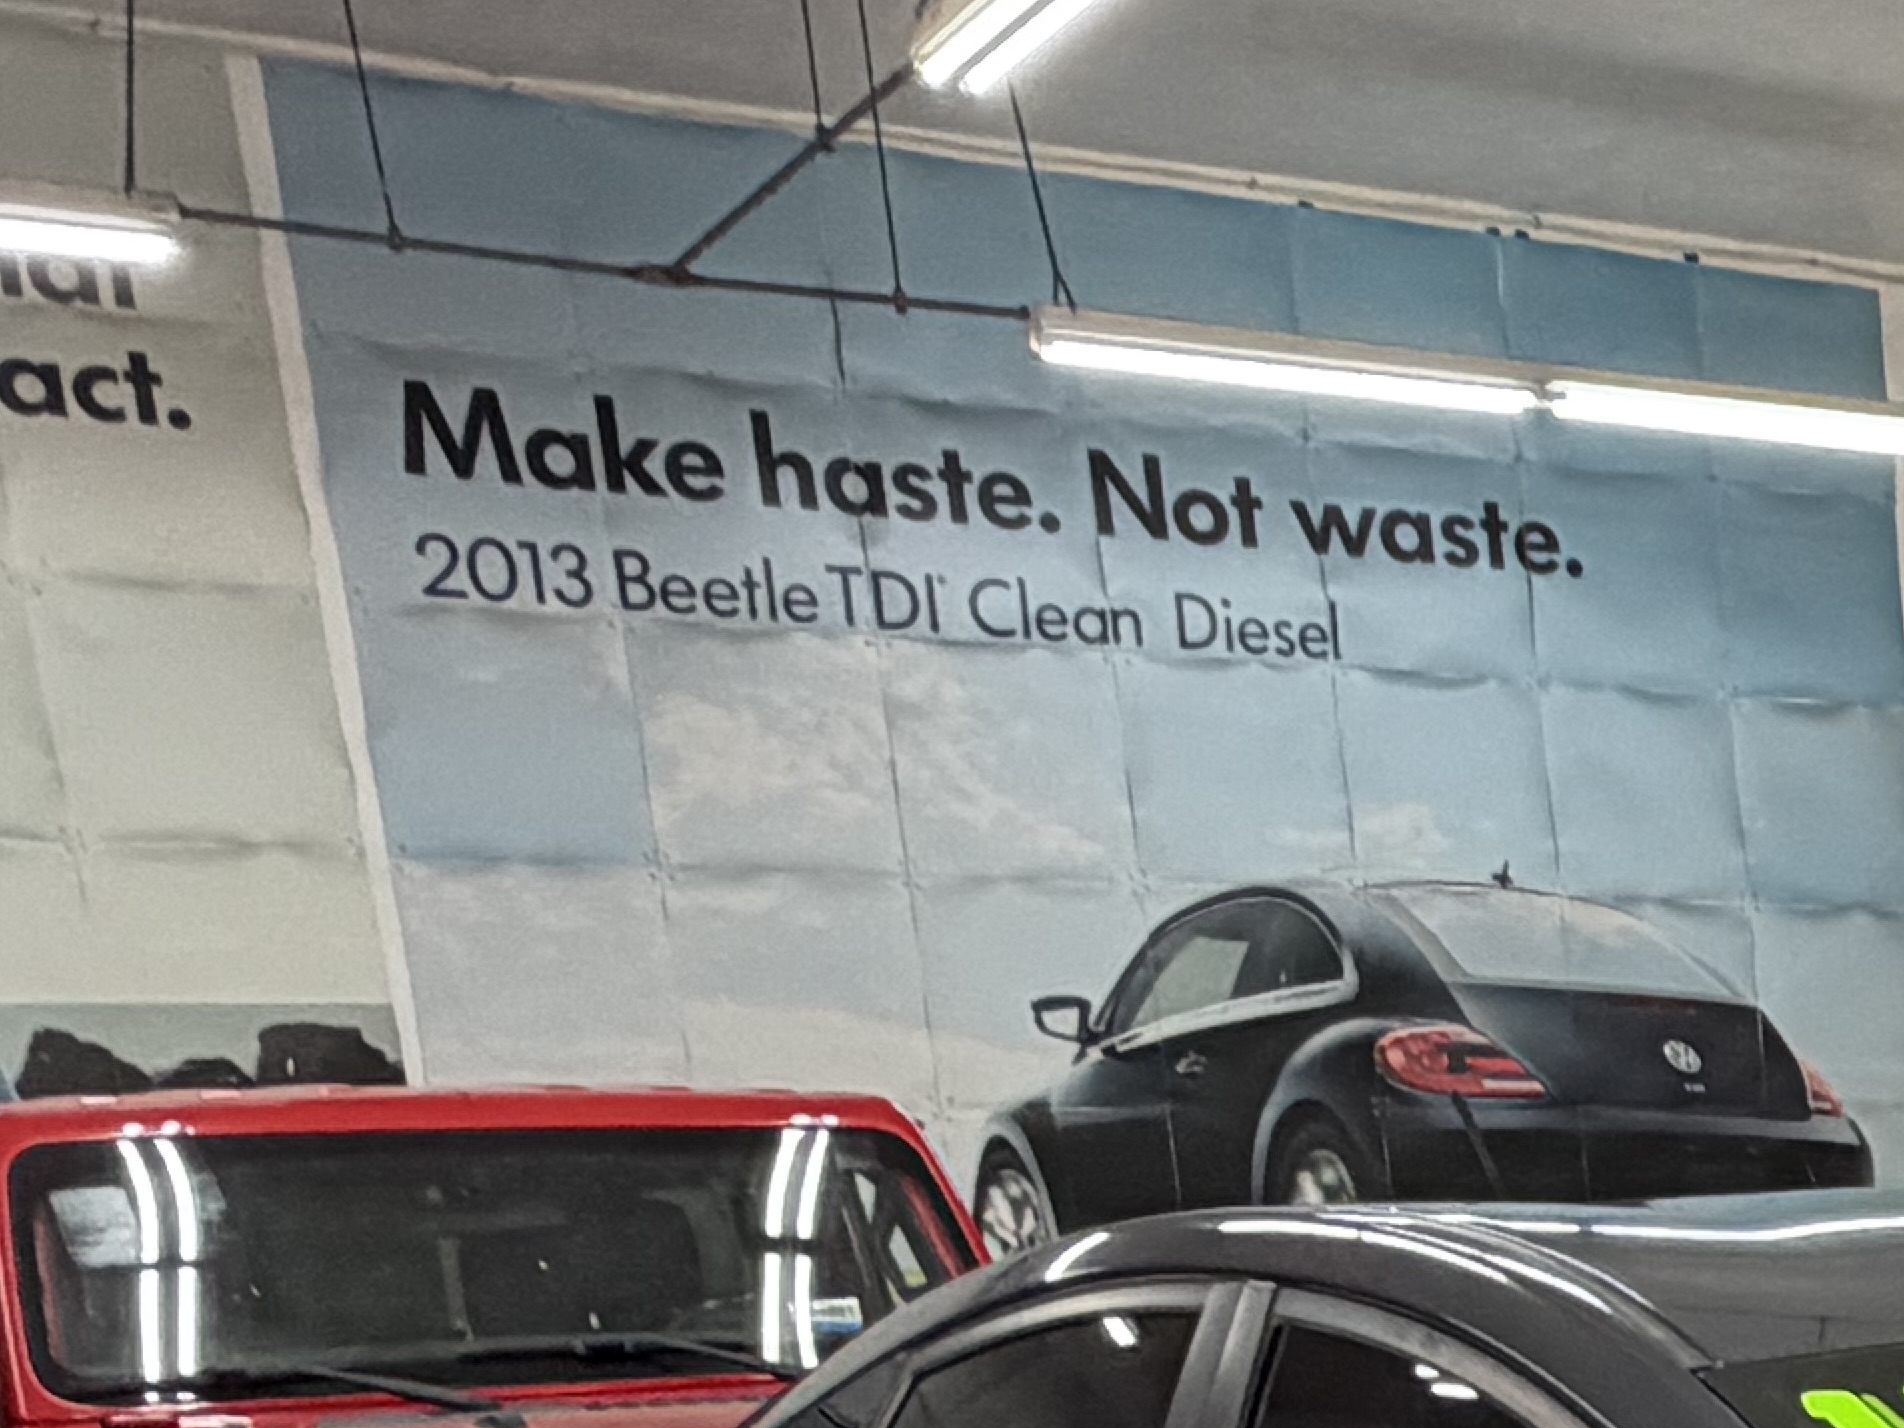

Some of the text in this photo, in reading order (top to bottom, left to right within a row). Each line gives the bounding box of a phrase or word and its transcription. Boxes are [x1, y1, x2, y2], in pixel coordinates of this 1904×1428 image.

[0, 350, 192, 431] act.
[404, 380, 1585, 588] Make haste. Not waste.
[414, 533, 595, 609] 2013
[611, 548, 820, 624] Beetle
[961, 577, 1144, 650] Clean
[1173, 590, 1343, 662] Diesel
